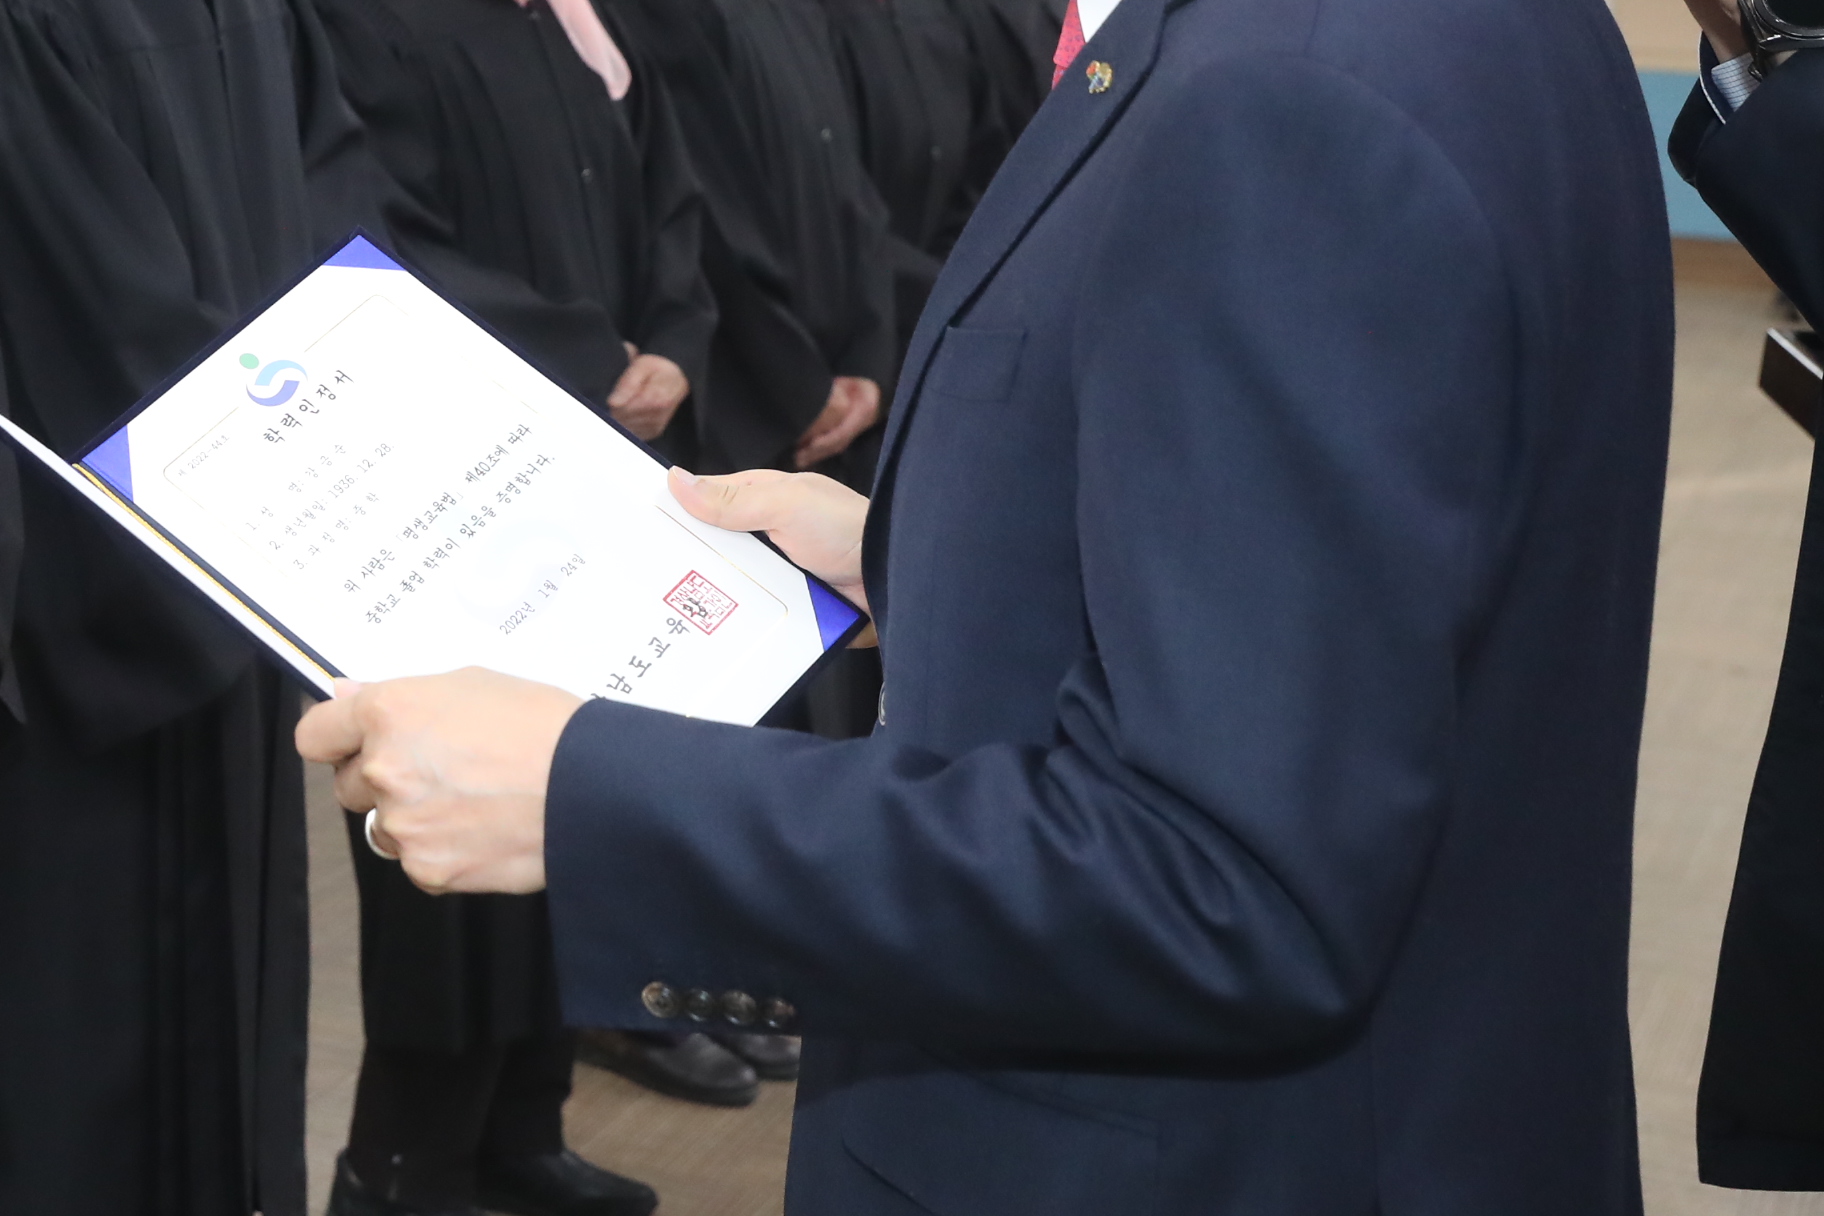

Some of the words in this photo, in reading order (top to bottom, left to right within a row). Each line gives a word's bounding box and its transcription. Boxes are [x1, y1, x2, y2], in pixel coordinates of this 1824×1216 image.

[361, 549, 395, 579] 사람은
[465, 444, 510, 484] 제40조에
[507, 424, 532, 444] 따라
[365, 594, 401, 624] 중학교
[422, 537, 461, 569] 학력이
[459, 506, 496, 539] 있음을
[499, 601, 535, 635] 2022년
[538, 580, 558, 598] 1월
[560, 554, 585, 577] 24일
